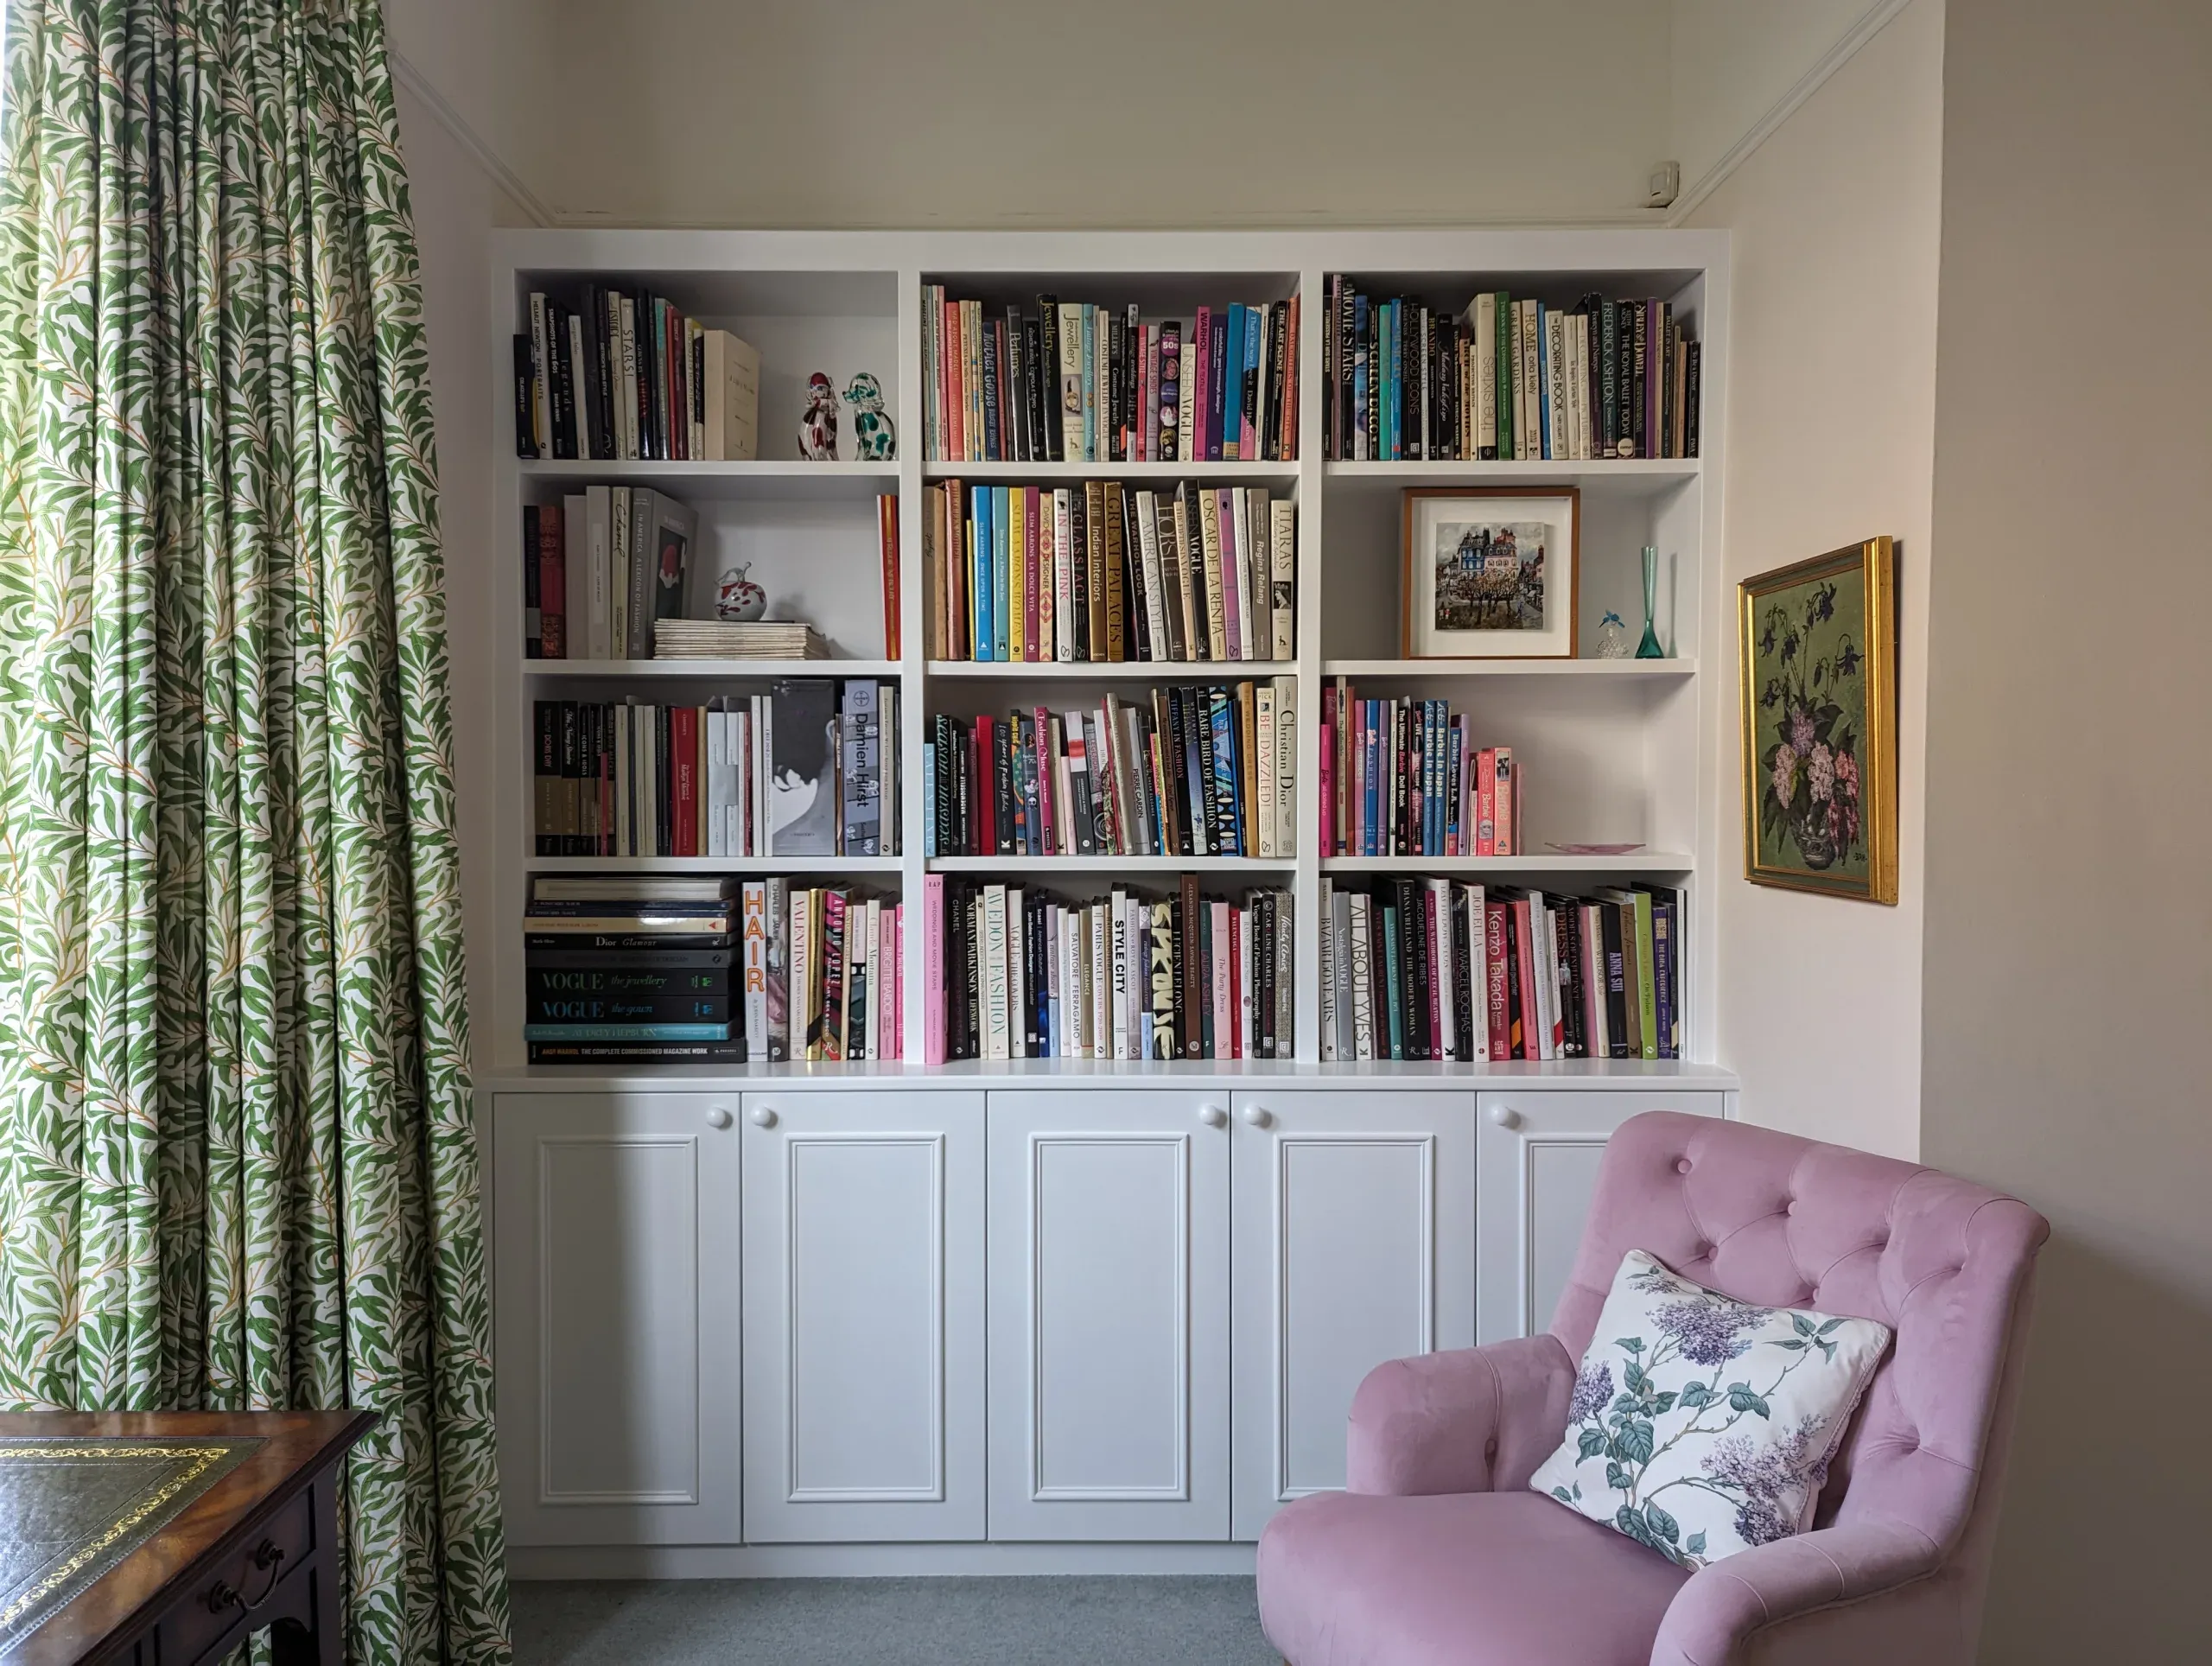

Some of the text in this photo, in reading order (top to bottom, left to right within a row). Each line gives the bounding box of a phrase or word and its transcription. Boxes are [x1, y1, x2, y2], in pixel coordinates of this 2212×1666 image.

[1009, 333, 1021, 378] Perfumes
[1039, 301, 1056, 352] Jewellery
[1064, 314, 1079, 367] Jewellery
[1343, 287, 1355, 381] MOVIE STARS
[1410, 303, 1420, 415] HOLLYWOOD ICONS
[1526, 312, 1535, 352] HOME
[1604, 302, 1614, 404] FREDERICK ASHTON
[983, 333, 997, 407] Mother Goose
[1370, 342, 1378, 434] SCREEN DECO
[1481, 357, 1494, 431] the sixties
[1511, 347, 1520, 395] GARDENS
[1528, 375, 1536, 395] kiely
[1552, 325, 1563, 412] DECORATING BOOK
[637, 513, 643, 522] IN
[1058, 513, 1068, 601] IN THE PINK
[1131, 521, 1140, 565] WARHOL
[1255, 540, 1265, 571] Regina
[1280, 507, 1292, 569] TIARAS
[1073, 514, 1084, 604] CLASS ACT
[1092, 525, 1102, 602] Indian Interiors
[1108, 498, 1121, 643] GREAT PALACES
[1141, 520, 1162, 633] AMERICAN STYLE
[1203, 499, 1223, 635] OSCAR DE LA RENTA
[1256, 574, 1265, 604] Relang
[856, 714, 869, 807] Damien Hirst
[1170, 698, 1183, 779] TIFFANY IN FASHION
[1199, 709, 1217, 829] RARE BIRD OF FASHION
[1260, 715, 1271, 807] BE DAZZLED!
[1280, 709, 1294, 807] Christian Dior
[543, 973, 604, 989] VOGUE
[596, 937, 616, 946] Dior
[745, 890, 765, 993] HAIR
[831, 900, 842, 985] ANTONIO LOPEZ
[883, 946, 892, 1015] BRIGITTE BARDOT
[988, 890, 1006, 1034] AVEDON FASHION
[1116, 920, 1125, 994] STYLE CITY
[1151, 902, 1174, 1059] SPROUSE
[1351, 906, 1370, 1041] ALL ABOUT YVES
[1418, 951, 1425, 961] DE
[1488, 910, 1504, 1010] Kenzo Takada
[1610, 952, 1623, 992] ANNA SUI
[543, 1002, 605, 1018] VOGUE
[1459, 949, 1470, 1033] MARCEL ROCHAS
